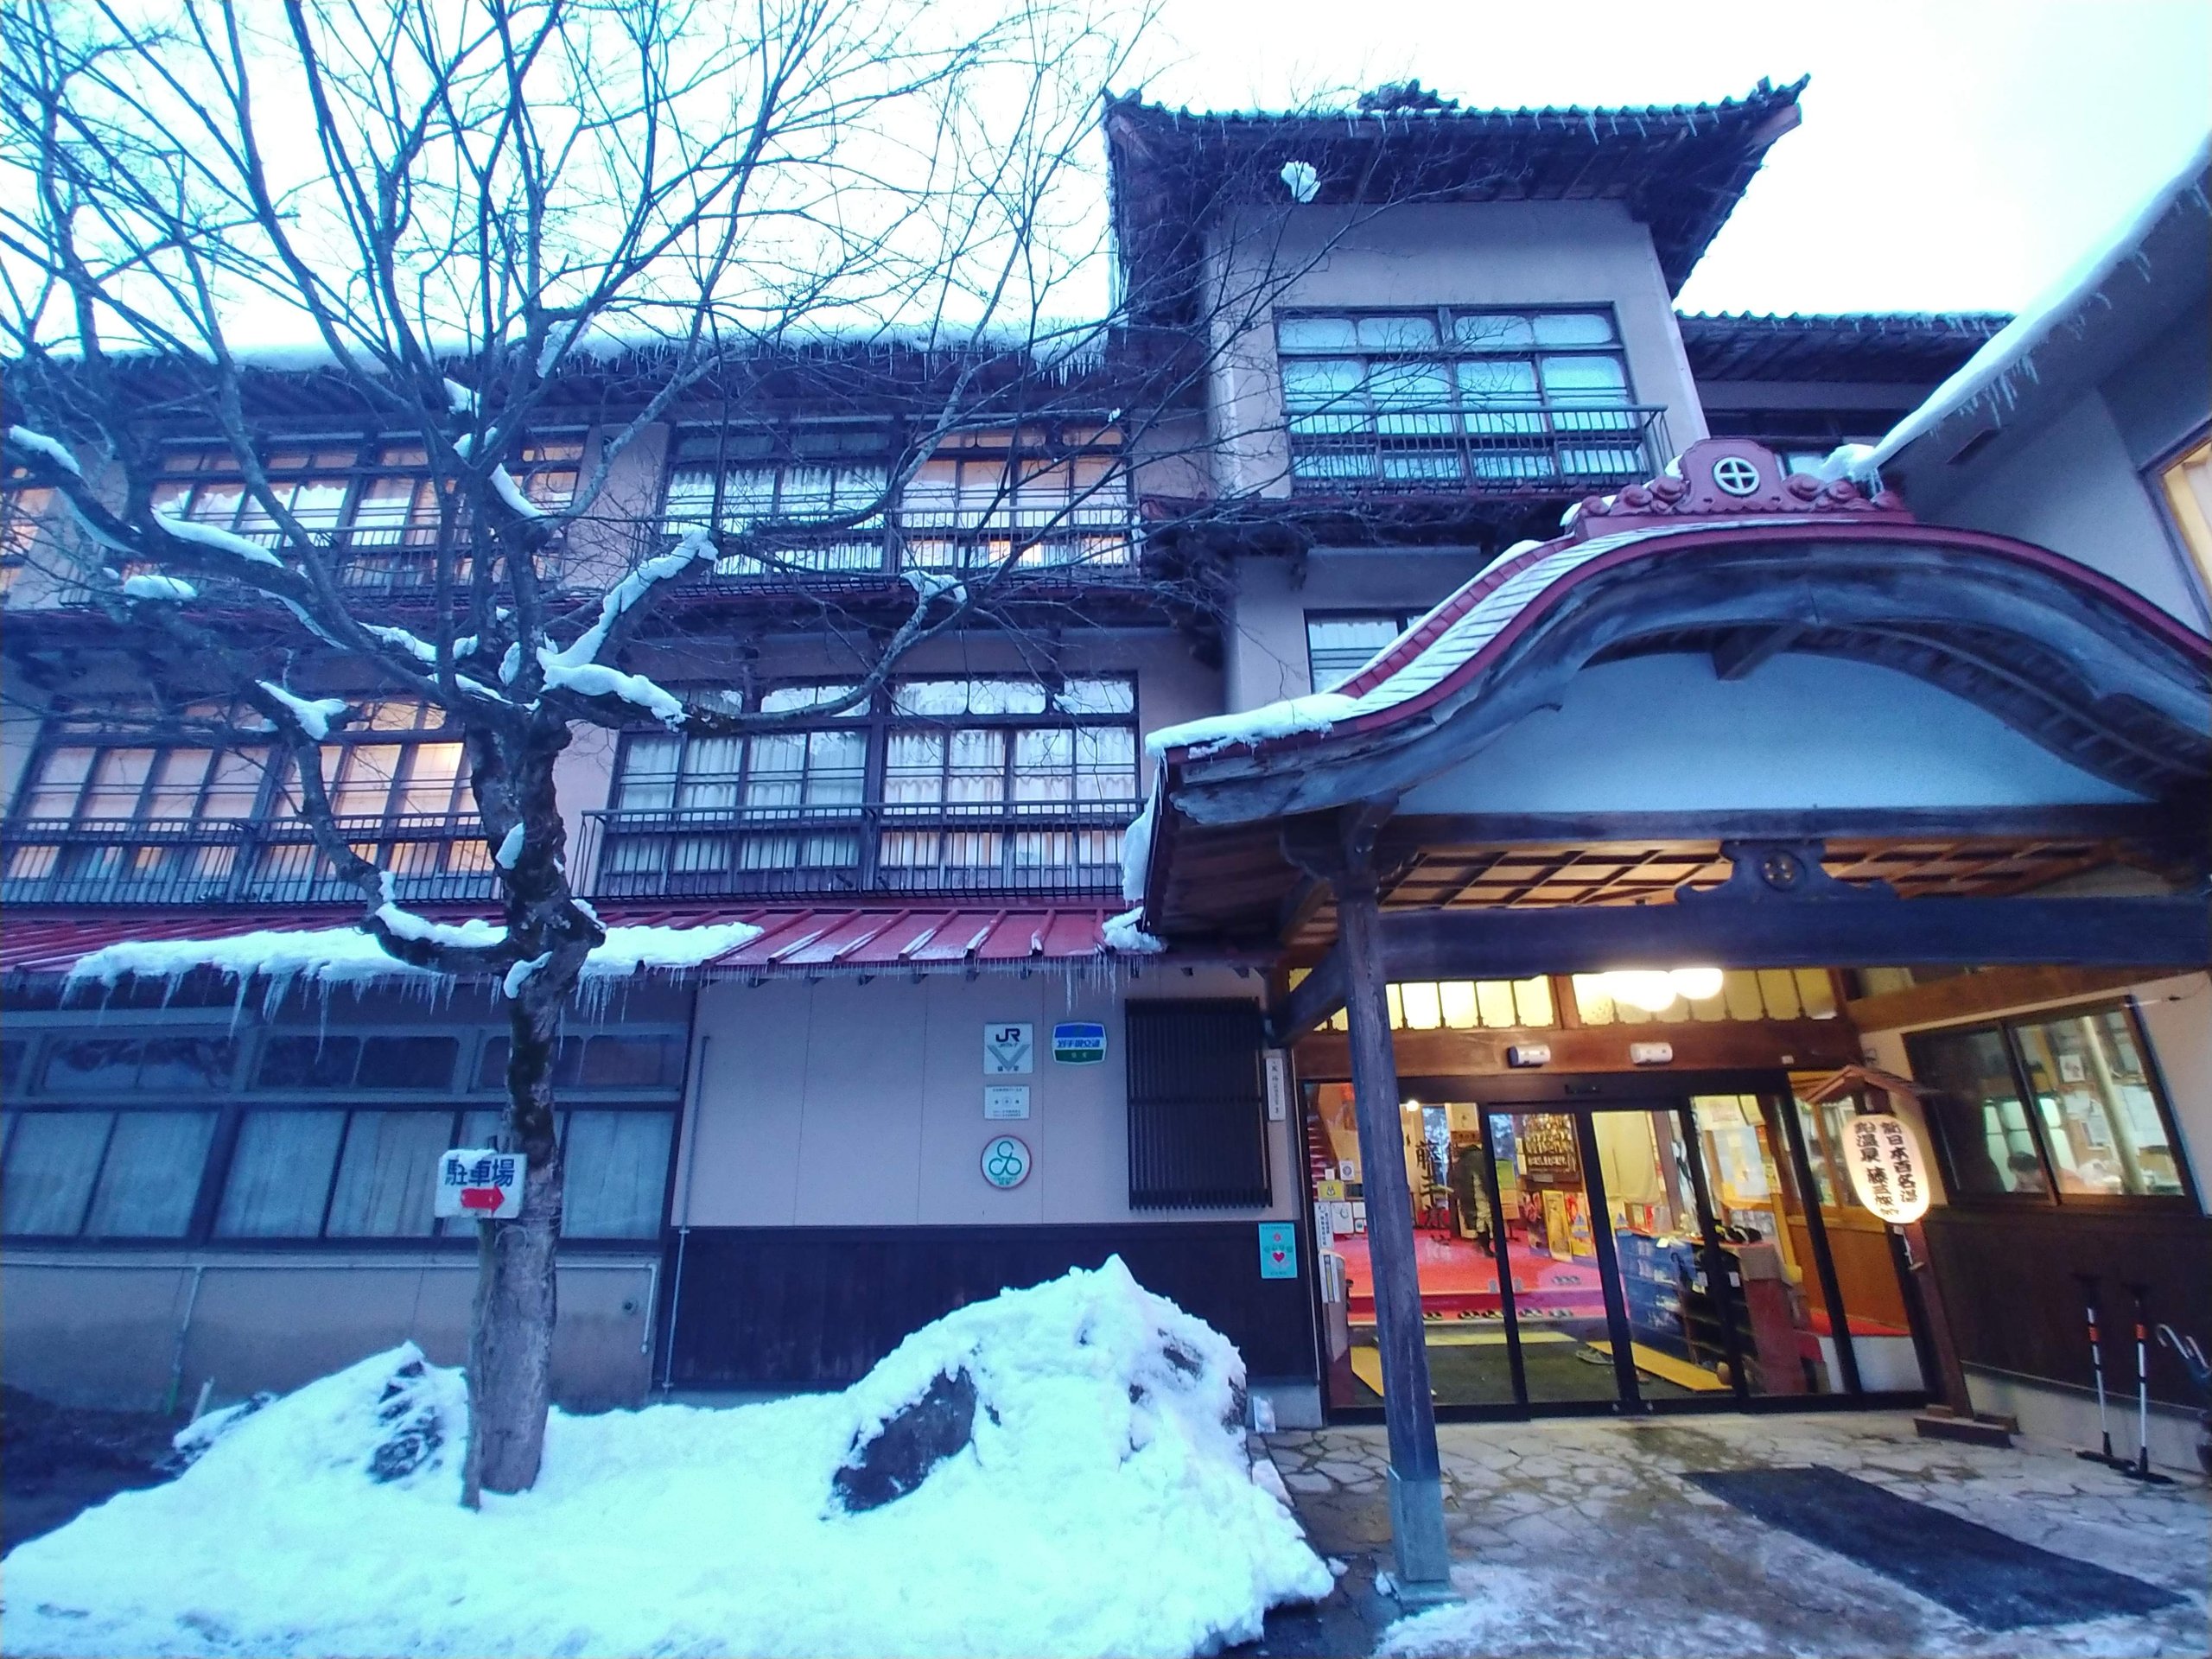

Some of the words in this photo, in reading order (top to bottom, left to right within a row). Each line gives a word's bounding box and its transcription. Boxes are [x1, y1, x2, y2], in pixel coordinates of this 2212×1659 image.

[995, 1027, 1020, 1042] JR
[444, 1157, 515, 1187] 駐車場
